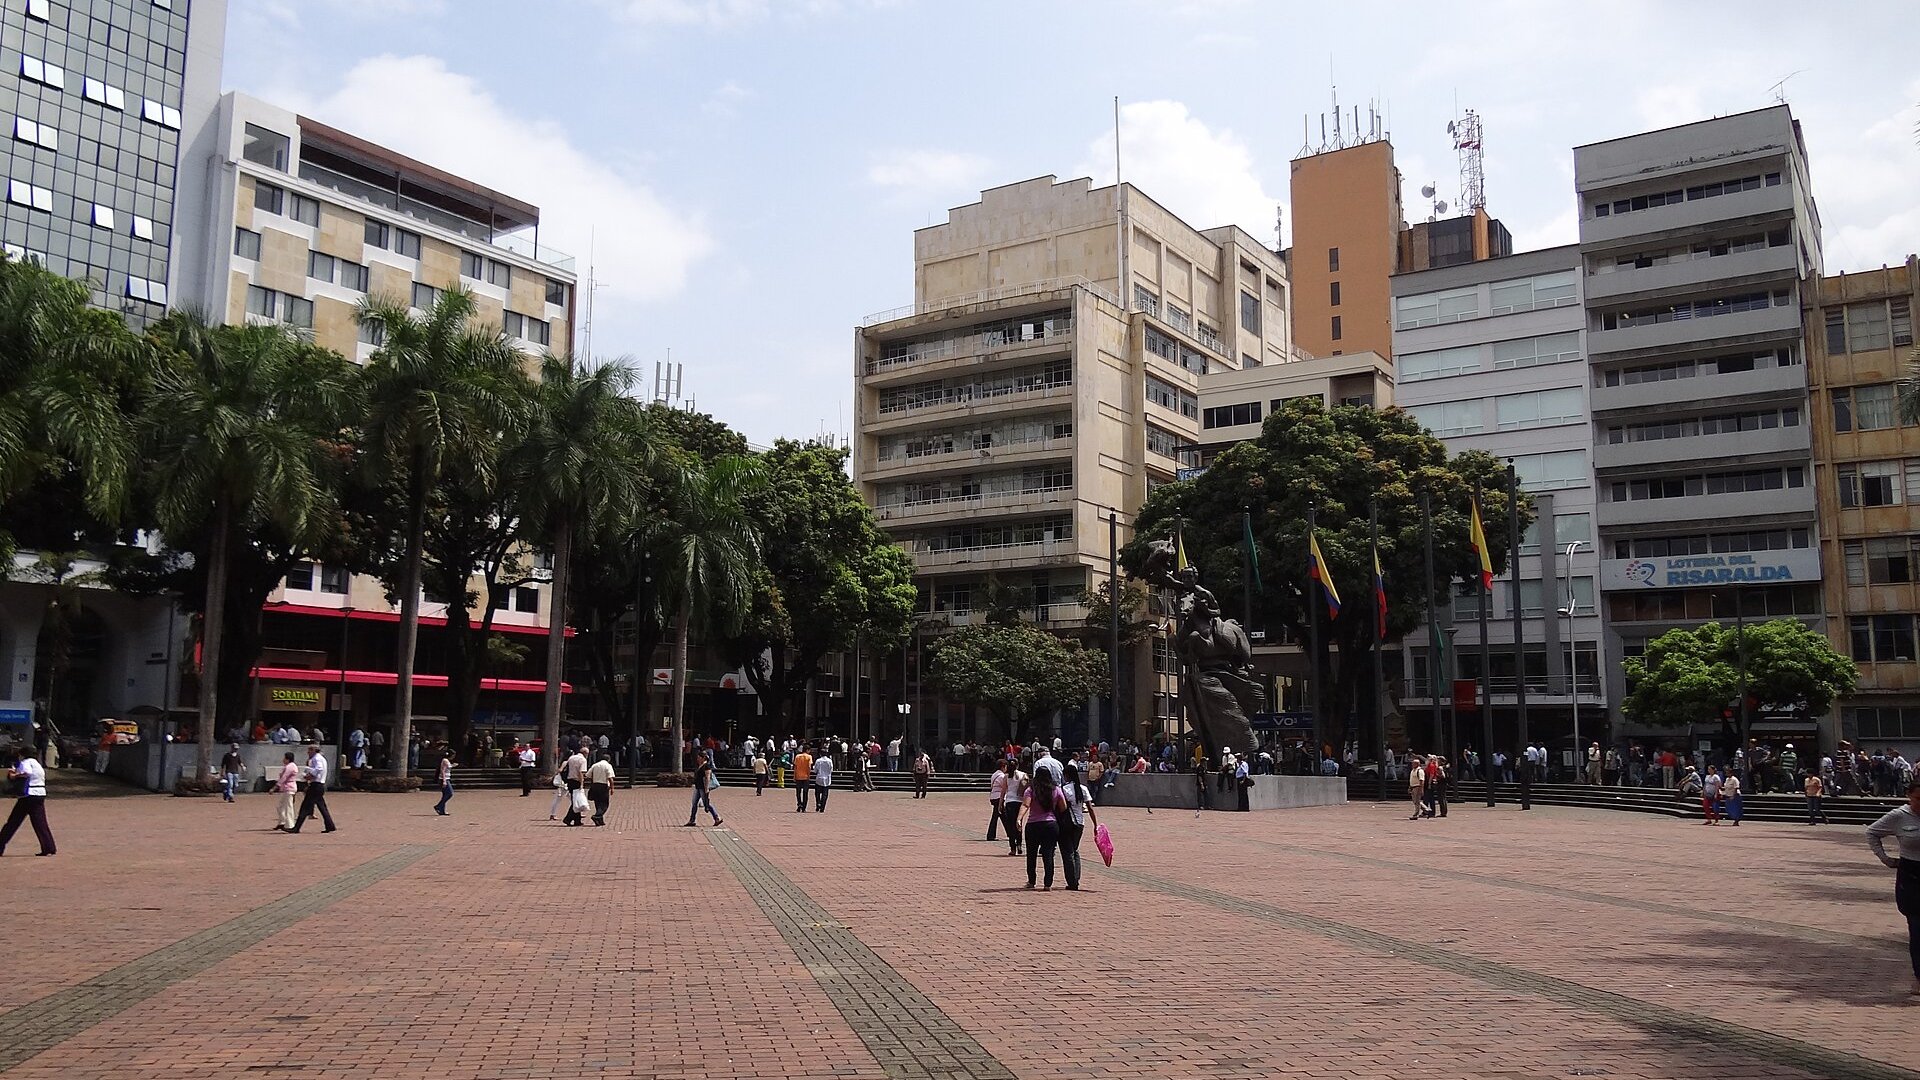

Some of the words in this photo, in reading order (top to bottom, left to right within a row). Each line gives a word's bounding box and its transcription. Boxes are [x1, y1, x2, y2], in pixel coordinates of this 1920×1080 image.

[1667, 556, 1726, 569] LOTERIA
[1729, 555, 1756, 565] DEL
[1667, 566, 1792, 585] RISARALDA
[273, 689, 320, 700] SORATAMA
